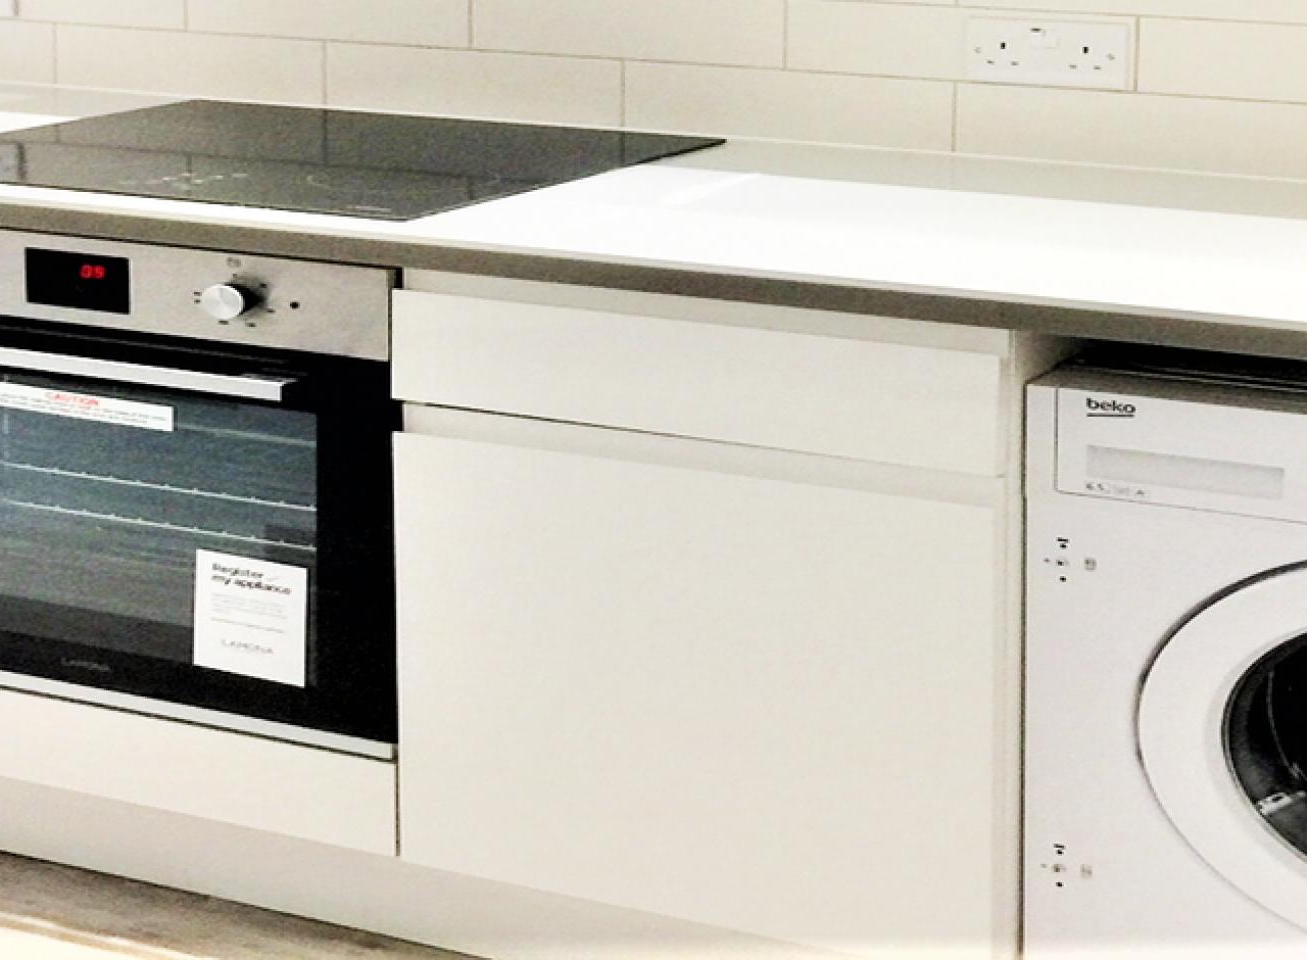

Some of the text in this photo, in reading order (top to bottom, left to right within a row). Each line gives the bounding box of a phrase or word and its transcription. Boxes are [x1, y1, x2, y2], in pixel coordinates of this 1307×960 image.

[1086, 397, 1136, 415] beko
[212, 563, 264, 578] Register
[211, 575, 291, 596] my appliance
